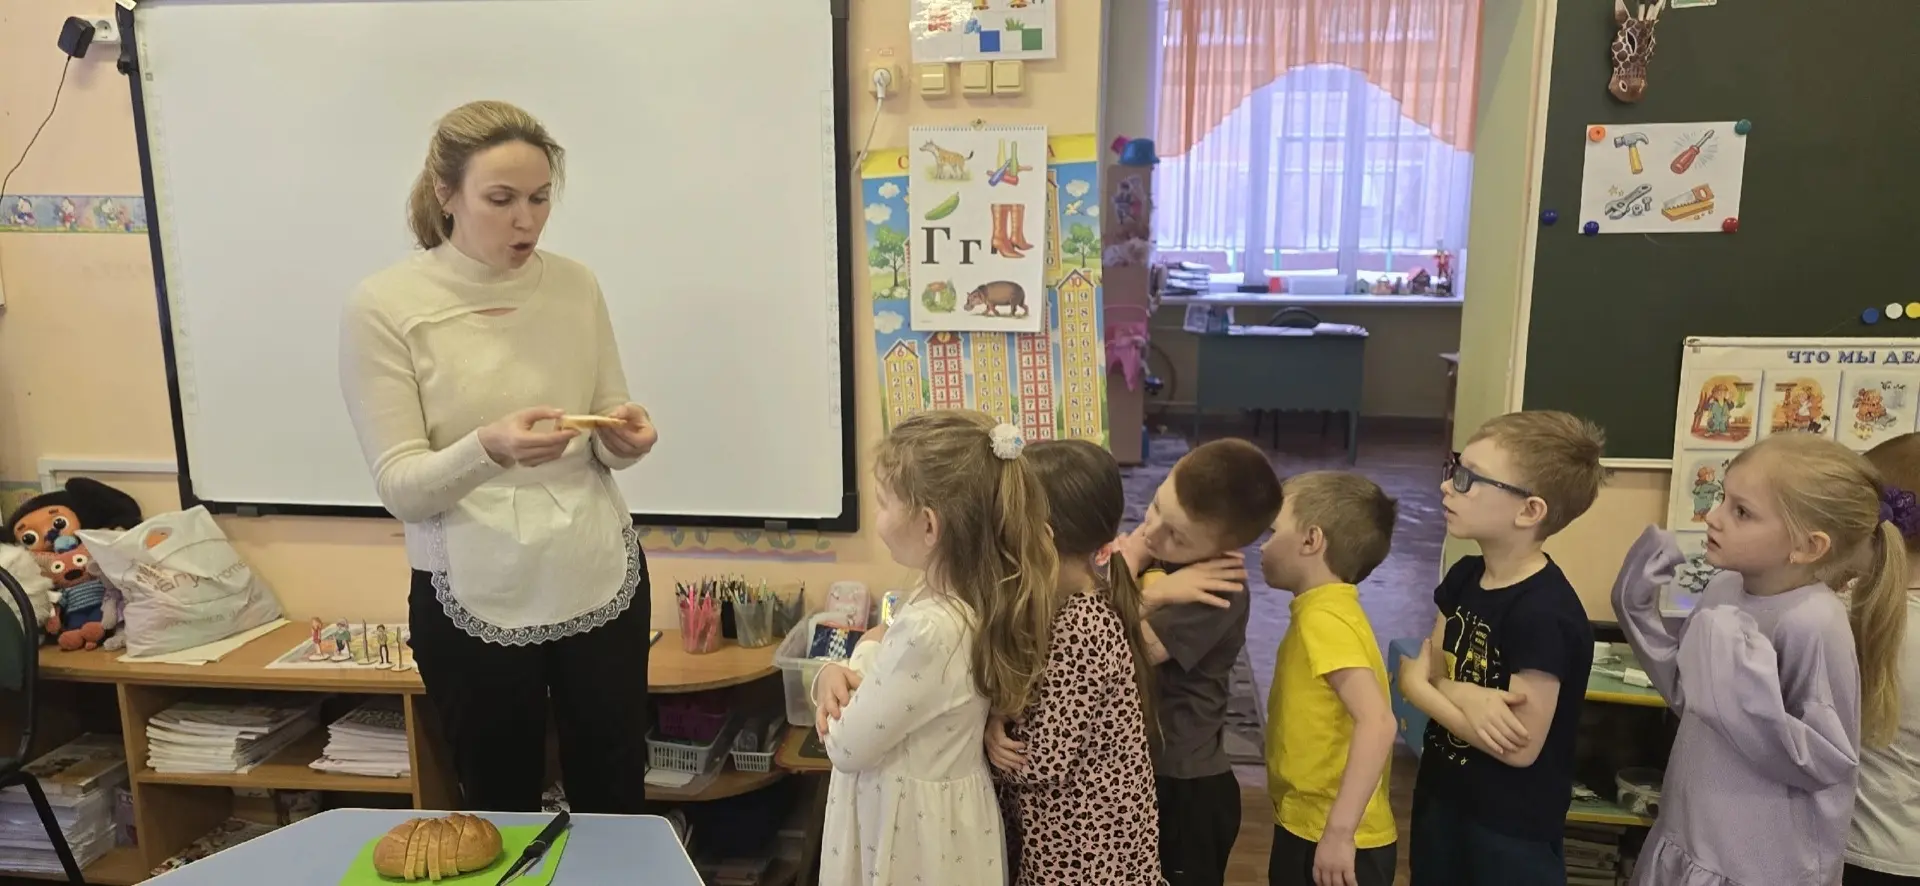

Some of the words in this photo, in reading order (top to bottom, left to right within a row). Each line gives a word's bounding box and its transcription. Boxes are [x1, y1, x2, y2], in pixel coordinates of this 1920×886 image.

[922, 226, 950, 264] Г
[959, 240, 982, 264] г
[1068, 293, 1072, 302] 1
[1080, 292, 1088, 301] 9
[1067, 309, 1073, 317] 2
[1081, 308, 1088, 317] 8
[1068, 324, 1075, 332] 3
[1082, 323, 1088, 331] 7
[979, 344, 985, 352] 2
[992, 344, 999, 352] 6
[1068, 339, 1074, 348] 4
[1082, 339, 1089, 348] 6
[898, 347, 905, 357] 6
[1024, 356, 1030, 365] 4
[1039, 355, 1045, 364] 5
[1069, 354, 1076, 362] 5
[1083, 353, 1090, 362] 5
[1787, 351, 1830, 364] ЧТО
[1837, 351, 1876, 364] МЫ
[936, 362, 942, 370] 2
[950, 362, 956, 370] 5
[979, 358, 986, 367] 3
[994, 358, 1000, 367] 5
[893, 363, 898, 372] 1
[906, 363, 913, 372] 5
[1084, 367, 1090, 377] 4
[980, 373, 987, 383] 4
[994, 372, 1001, 381] 4
[1025, 371, 1032, 380] 5
[1039, 370, 1045, 379] 4
[893, 379, 900, 387] 2
[907, 377, 913, 386] 4
[936, 377, 944, 385] 3
[951, 375, 957, 384] 4
[981, 388, 988, 396] 5
[1025, 386, 1032, 394] 6
[1040, 385, 1047, 393] 3
[1071, 383, 1078, 392] 7
[1085, 383, 1091, 391] 3
[895, 392, 901, 401] 3
[909, 392, 915, 401] 3
[938, 390, 944, 399] 4
[952, 390, 958, 398] 3
[982, 403, 989, 412] 6
[996, 401, 1002, 410] 2
[1026, 400, 1033, 408] 7
[1040, 399, 1047, 408] 2
[1071, 398, 1078, 407] 8
[1085, 398, 1092, 406] 2
[896, 407, 902, 416] 4
[1027, 414, 1034, 423] 8
[1042, 413, 1047, 422] 1
[1072, 413, 1079, 421] 9
[1087, 412, 1092, 421] 1
[1028, 428, 1035, 437] 9
[1042, 427, 1049, 437] 0
[1087, 427, 1093, 436] 0
